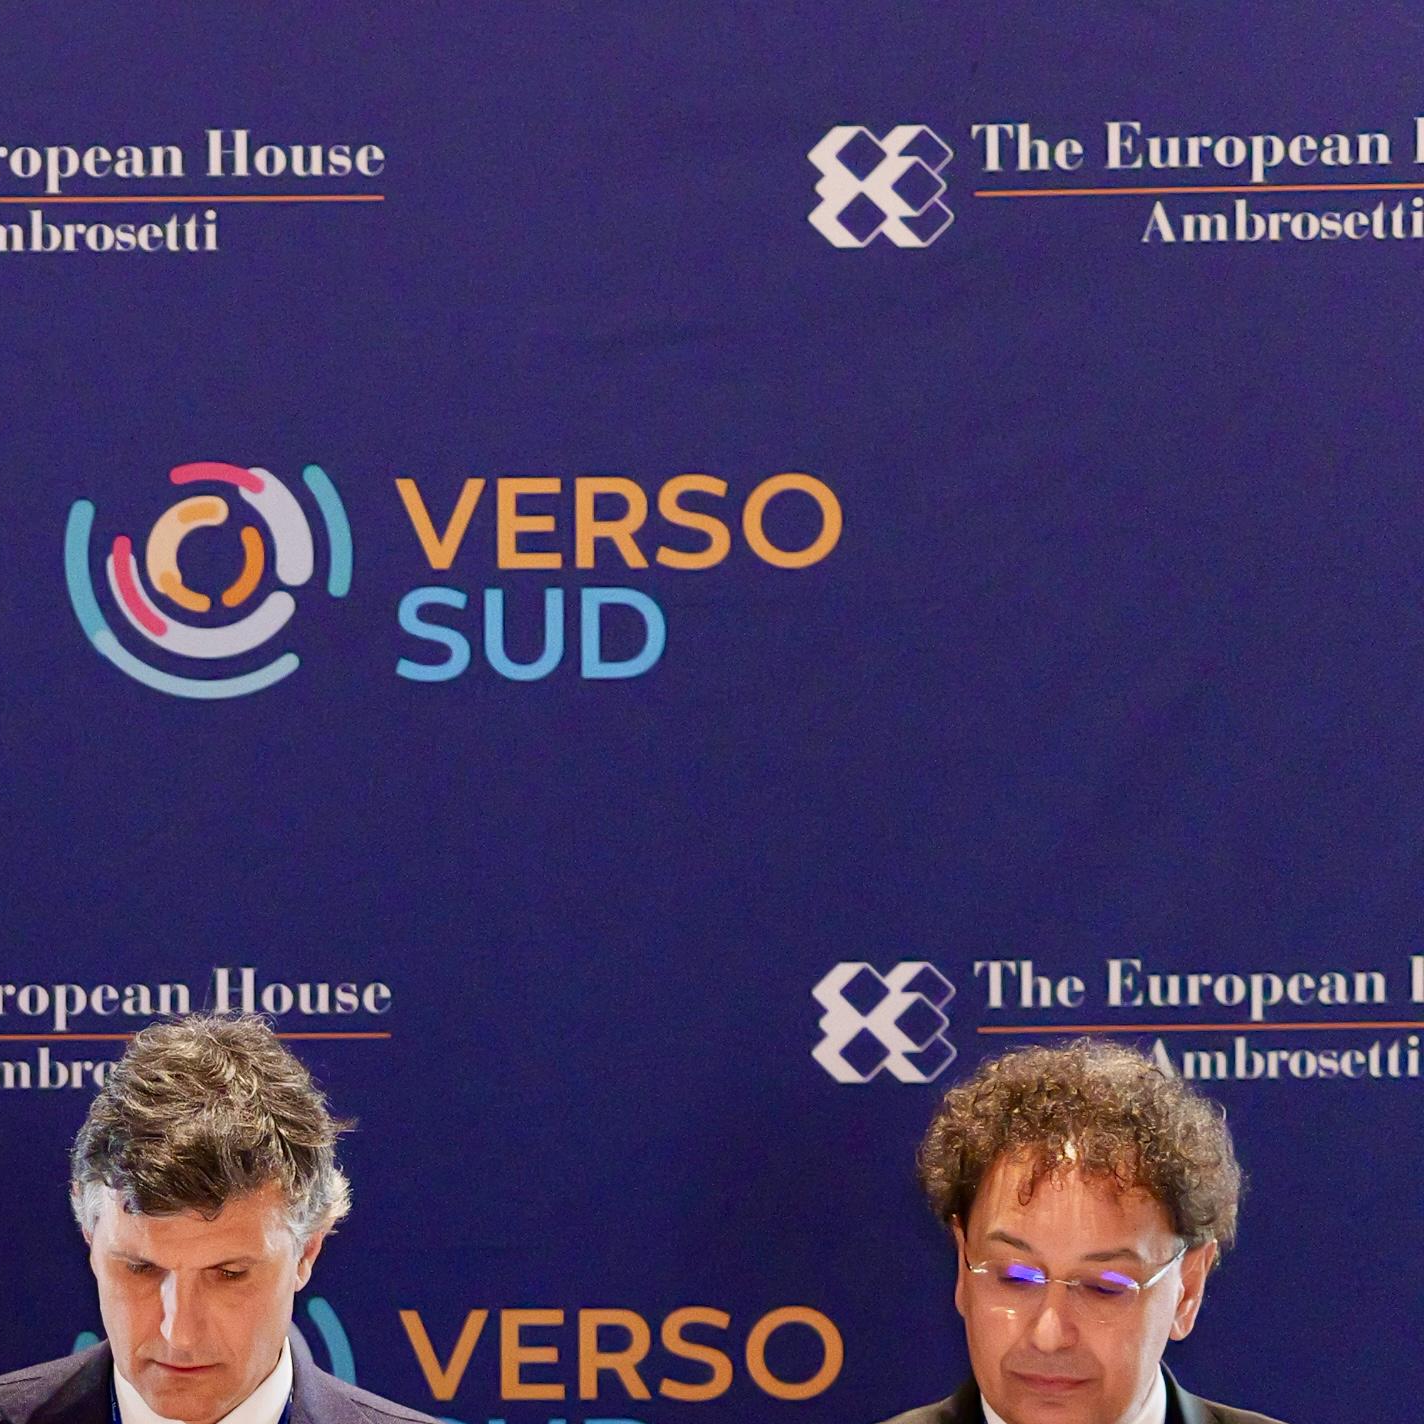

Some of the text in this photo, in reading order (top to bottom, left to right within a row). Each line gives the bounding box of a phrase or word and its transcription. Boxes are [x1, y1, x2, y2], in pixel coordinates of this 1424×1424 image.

[206, 130, 385, 177] House
[971, 123, 1084, 172] The
[1105, 121, 1391, 183] European
[1142, 198, 1424, 243] Ambrosetti
[394, 472, 843, 571] VERSO
[395, 586, 667, 683] SUD
[213, 967, 392, 1015] House
[974, 960, 1085, 1008] The
[1108, 958, 1387, 1022] European
[398, 1305, 844, 1402] VERSO
